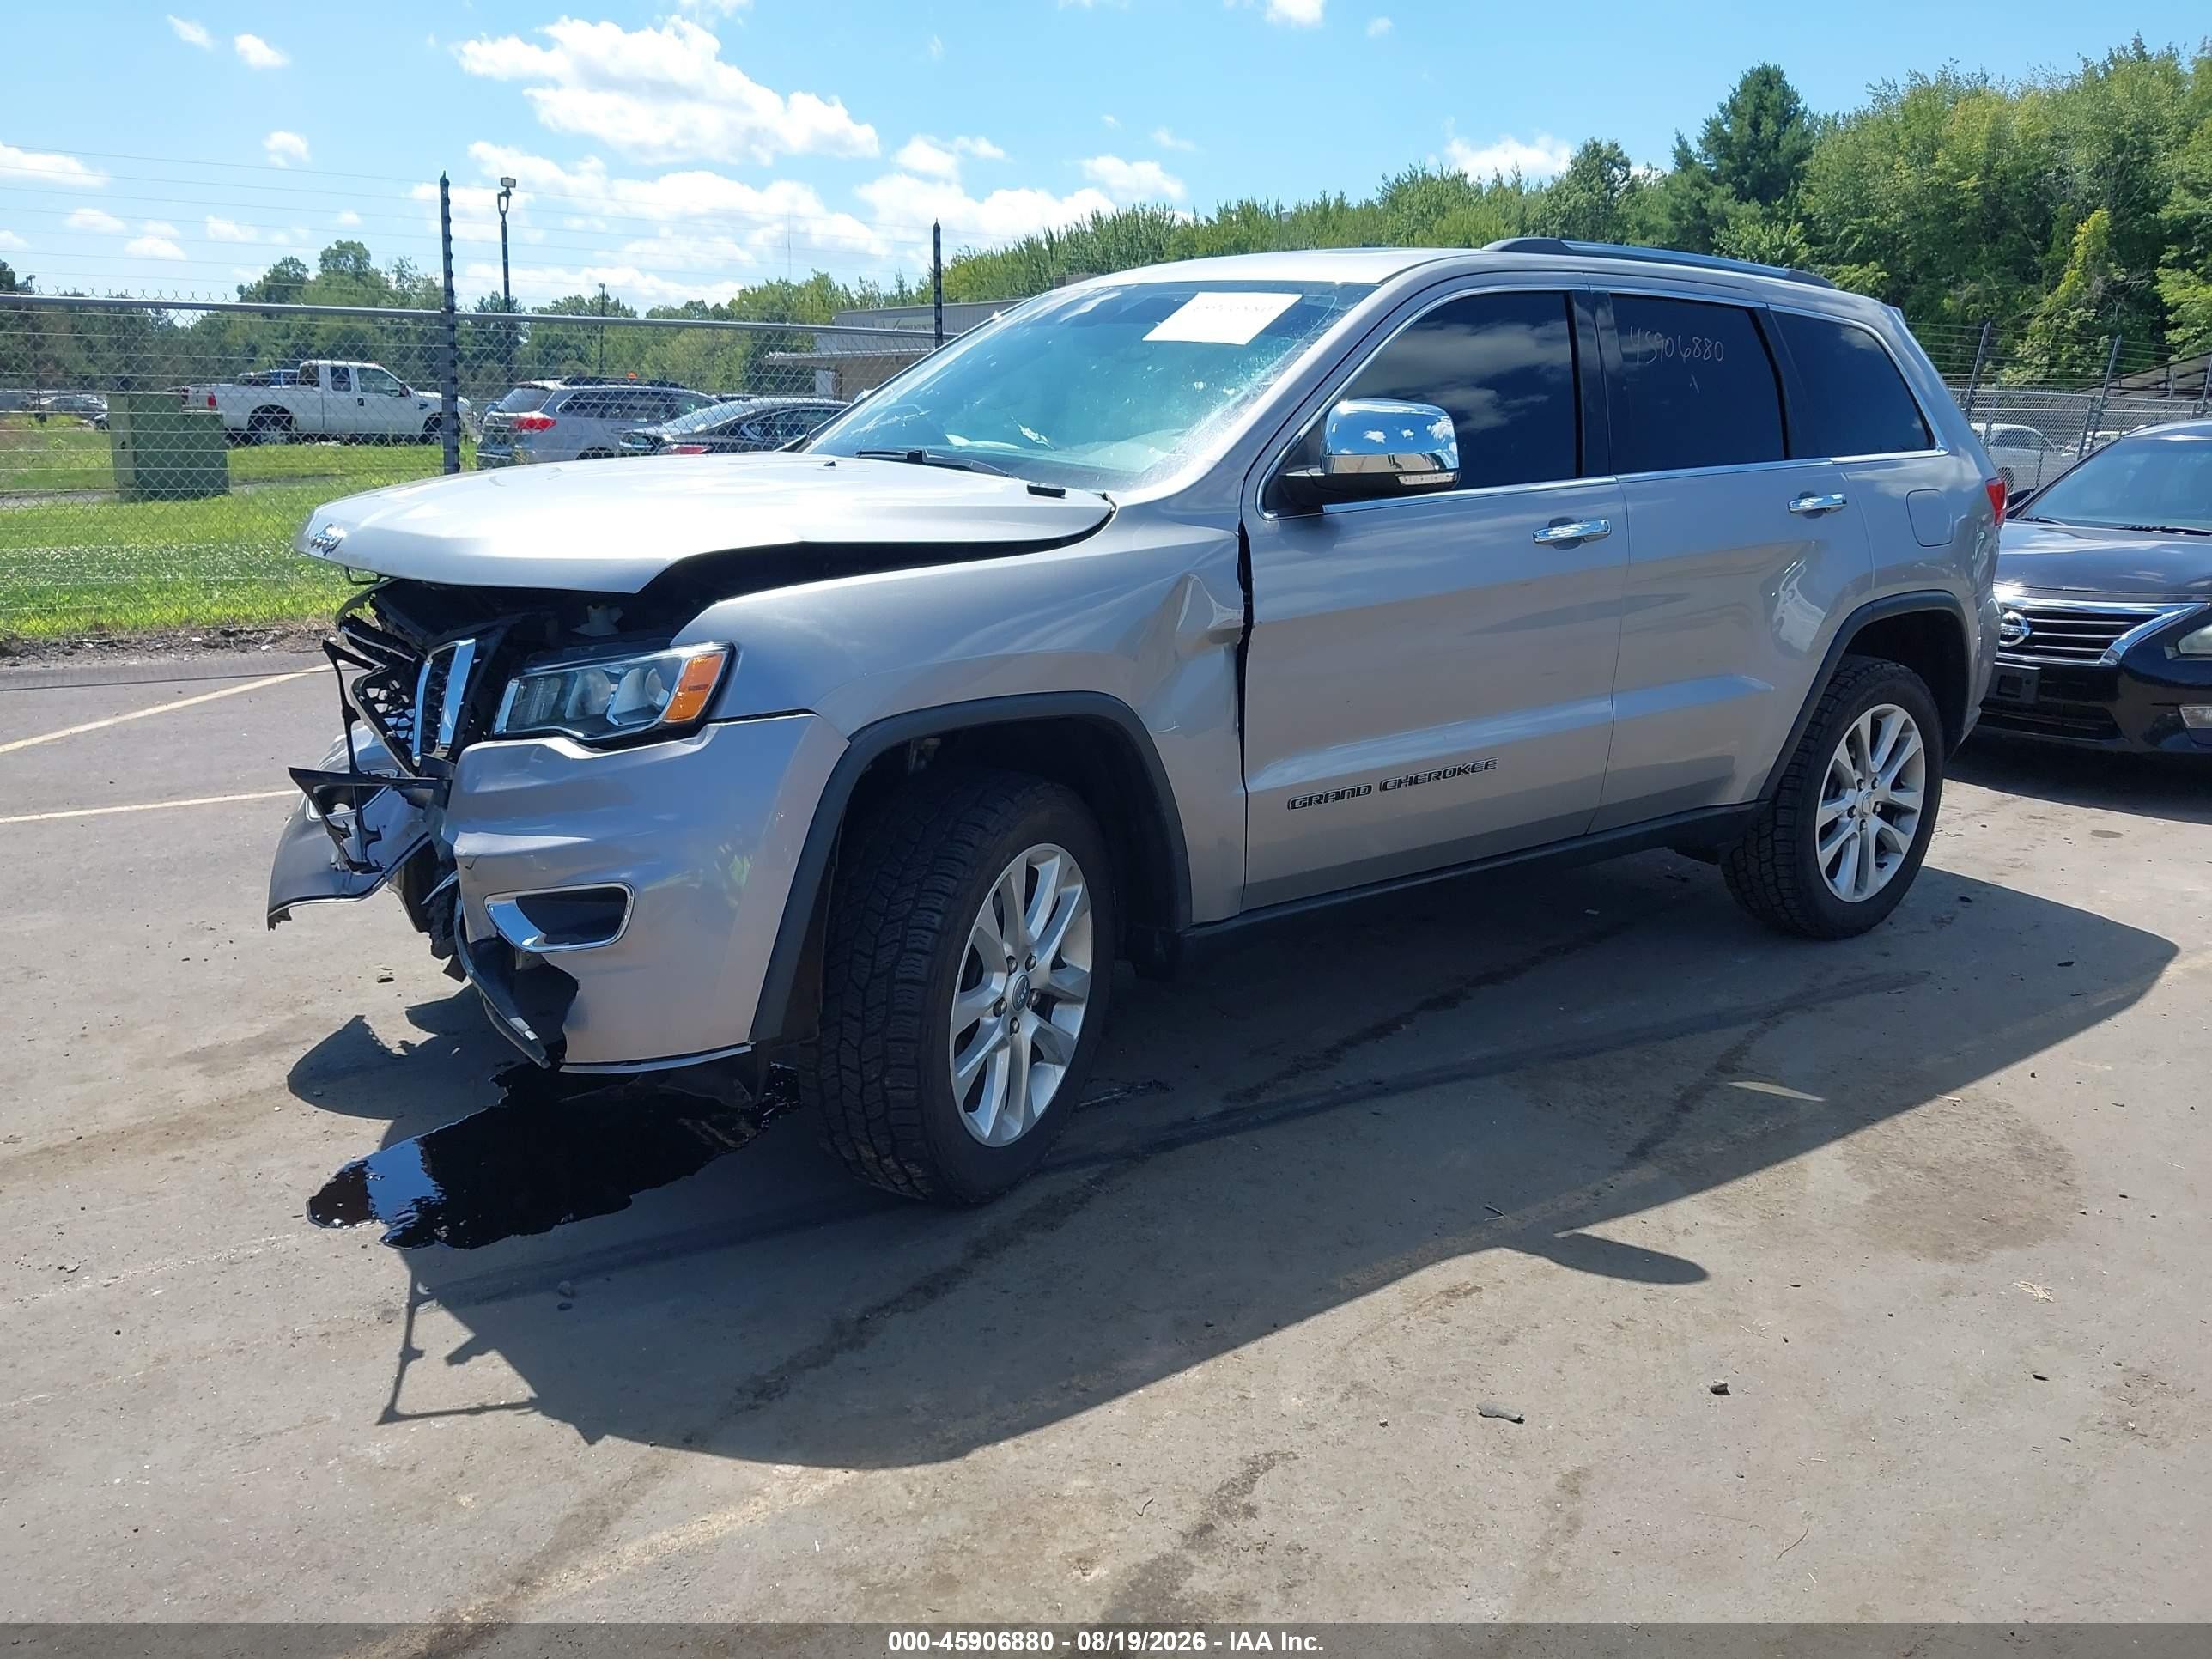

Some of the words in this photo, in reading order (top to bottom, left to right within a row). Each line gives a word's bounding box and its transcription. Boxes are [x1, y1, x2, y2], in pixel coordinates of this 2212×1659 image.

[1630, 325, 1724, 364] 45906880
[1287, 782, 1373, 811] GRAND
[1379, 757, 1498, 792] CHEROKEE
